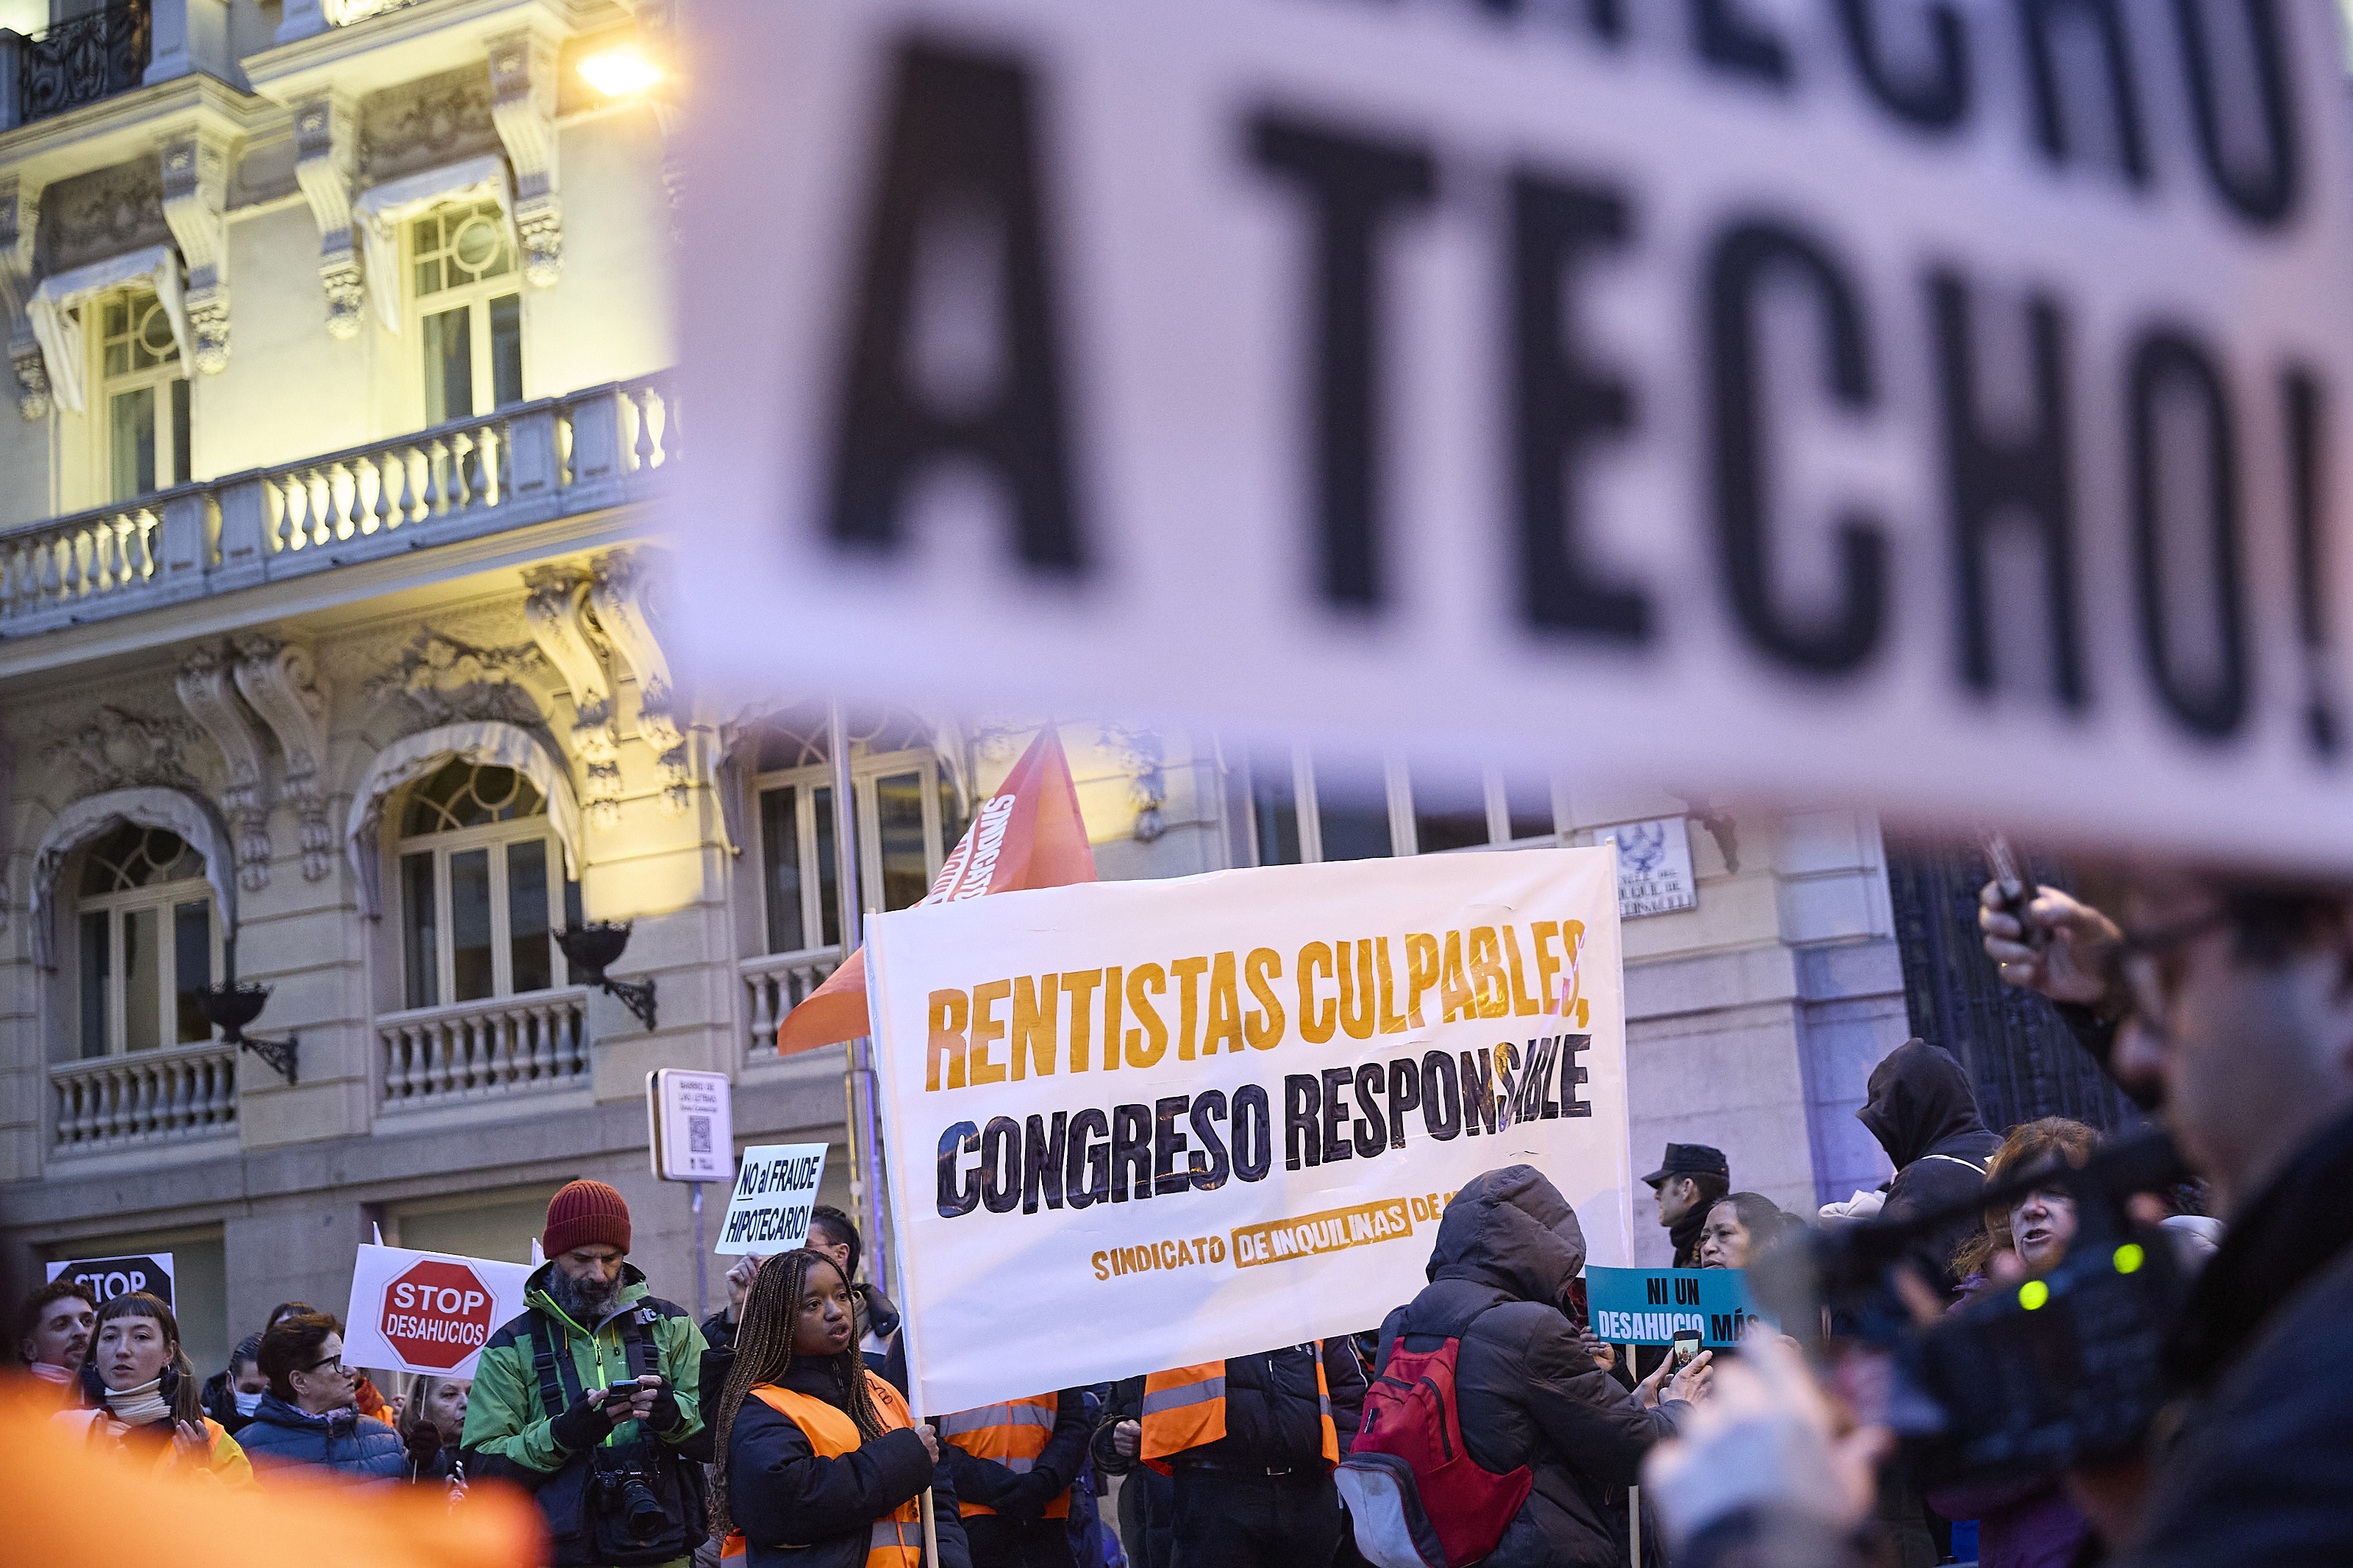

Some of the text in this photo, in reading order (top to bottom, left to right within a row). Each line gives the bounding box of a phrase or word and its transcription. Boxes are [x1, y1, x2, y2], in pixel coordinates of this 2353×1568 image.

[809, 33, 2346, 761] A TECHO!
[926, 919, 1590, 1092] RENTISTAS CULPABLES,
[937, 1034, 1592, 1218] CONGRESO RESPONSABLE
[738, 1156, 820, 1195] NO al FRAUDE
[725, 1205, 810, 1242] HIPOTECARIO!
[1091, 1236, 1226, 1281] SINDICATO
[1240, 1233, 1269, 1261] DE
[1272, 1206, 1407, 1257] INQUILINAS
[1410, 1192, 1443, 1222] DE
[393, 1282, 485, 1316] STOP
[1646, 1278, 1700, 1306] NI UN
[386, 1313, 485, 1347] DESAHUCIOS
